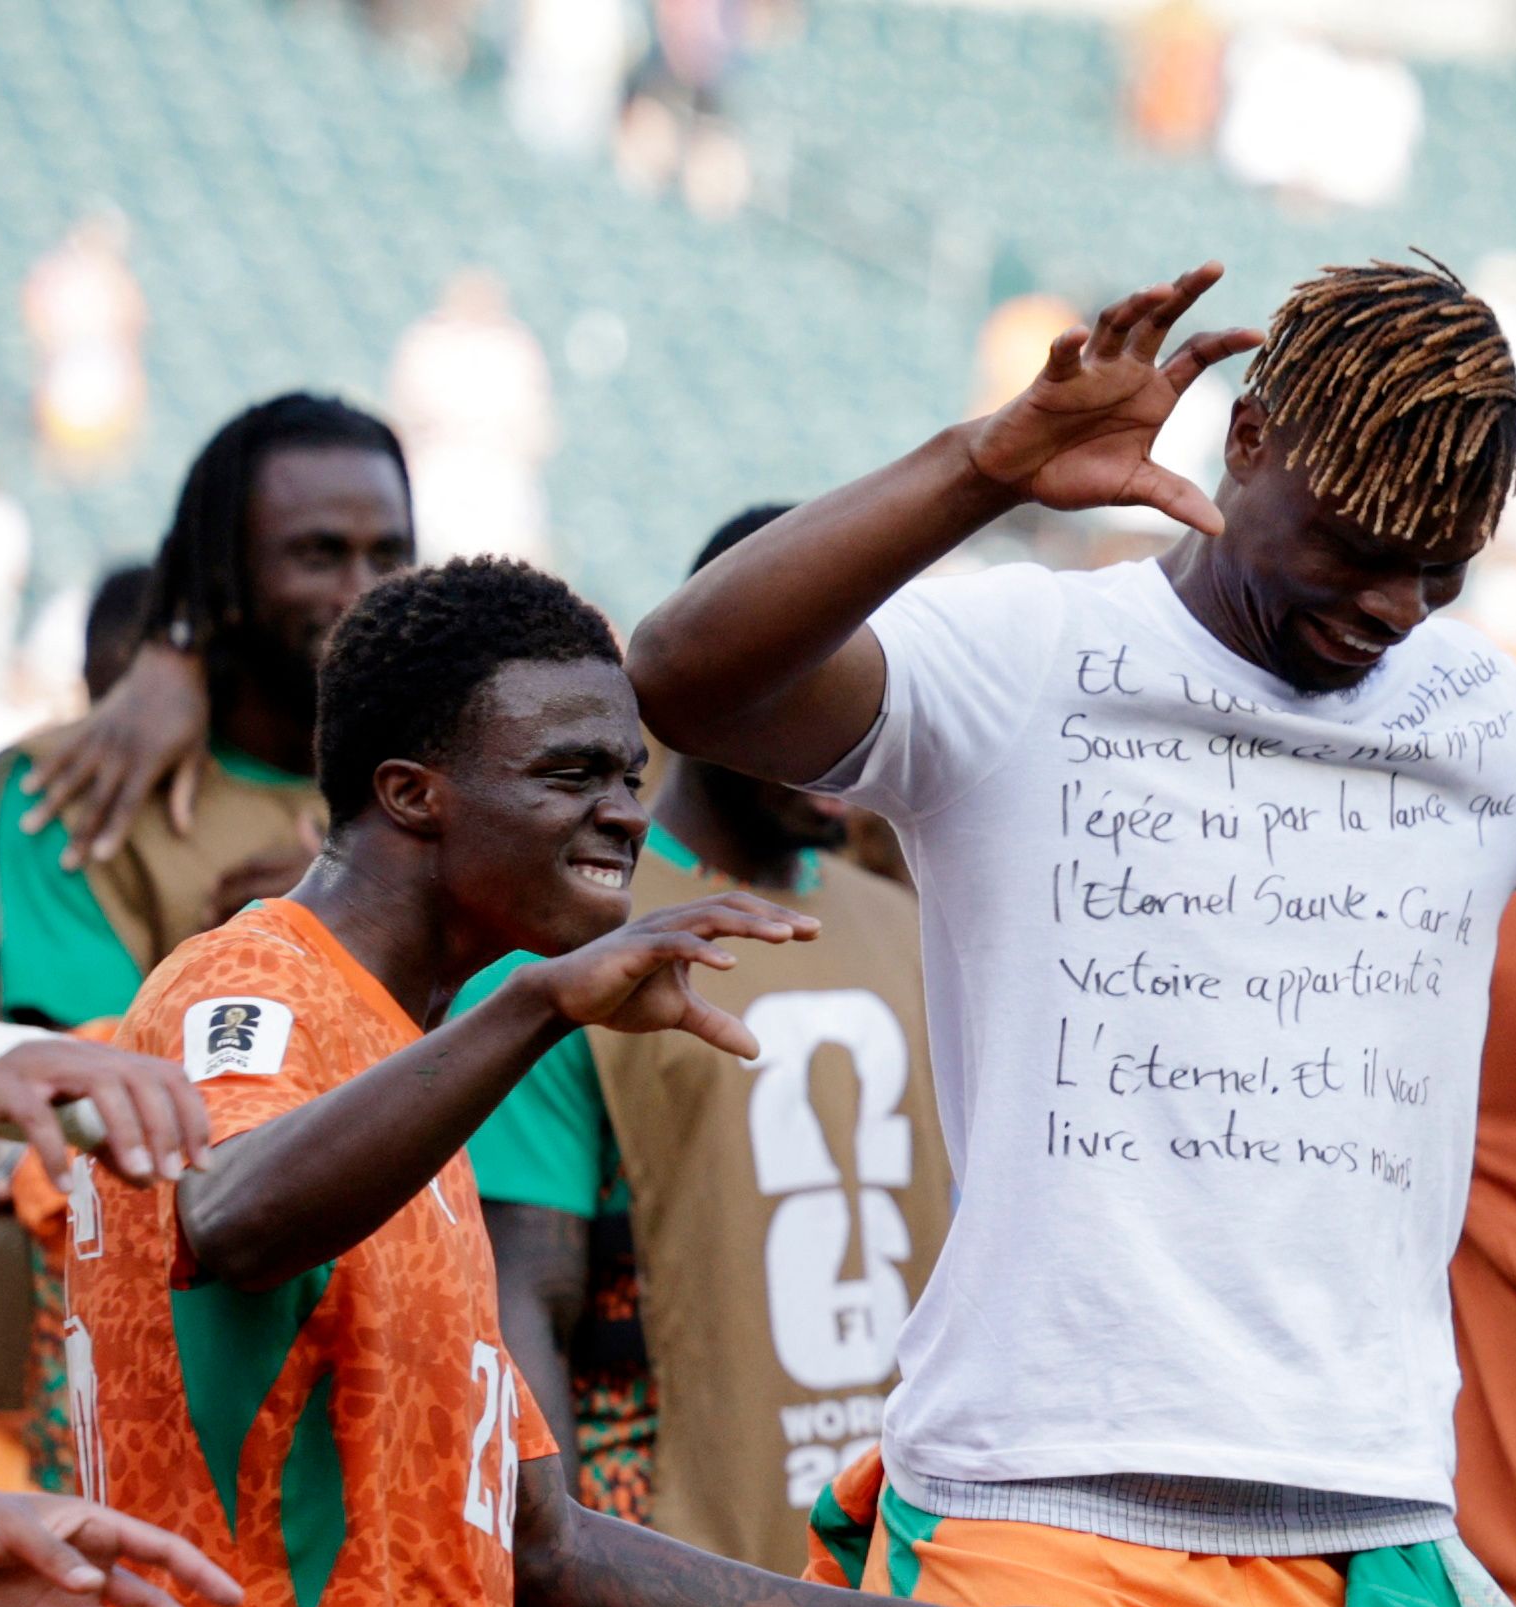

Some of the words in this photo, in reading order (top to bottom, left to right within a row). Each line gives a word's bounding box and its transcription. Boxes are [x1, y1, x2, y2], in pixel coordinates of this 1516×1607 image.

[1077, 645, 1143, 695] Et
[1208, 733, 1284, 790] que
[1468, 710, 1514, 772] par
[1061, 780, 1175, 857] l'épée
[1201, 805, 1239, 839] ni
[1256, 802, 1321, 867] par
[1339, 780, 1370, 832] la
[1390, 772, 1453, 830] lance
[1399, 886, 1449, 933] Car
[1245, 949, 1423, 1029] appartient
[1290, 1047, 1345, 1099] Et
[1364, 1047, 1378, 1098] il
[1047, 1111, 1140, 1162] livre
[1170, 1109, 1281, 1163] entre
[1298, 1139, 1359, 1173] nos
